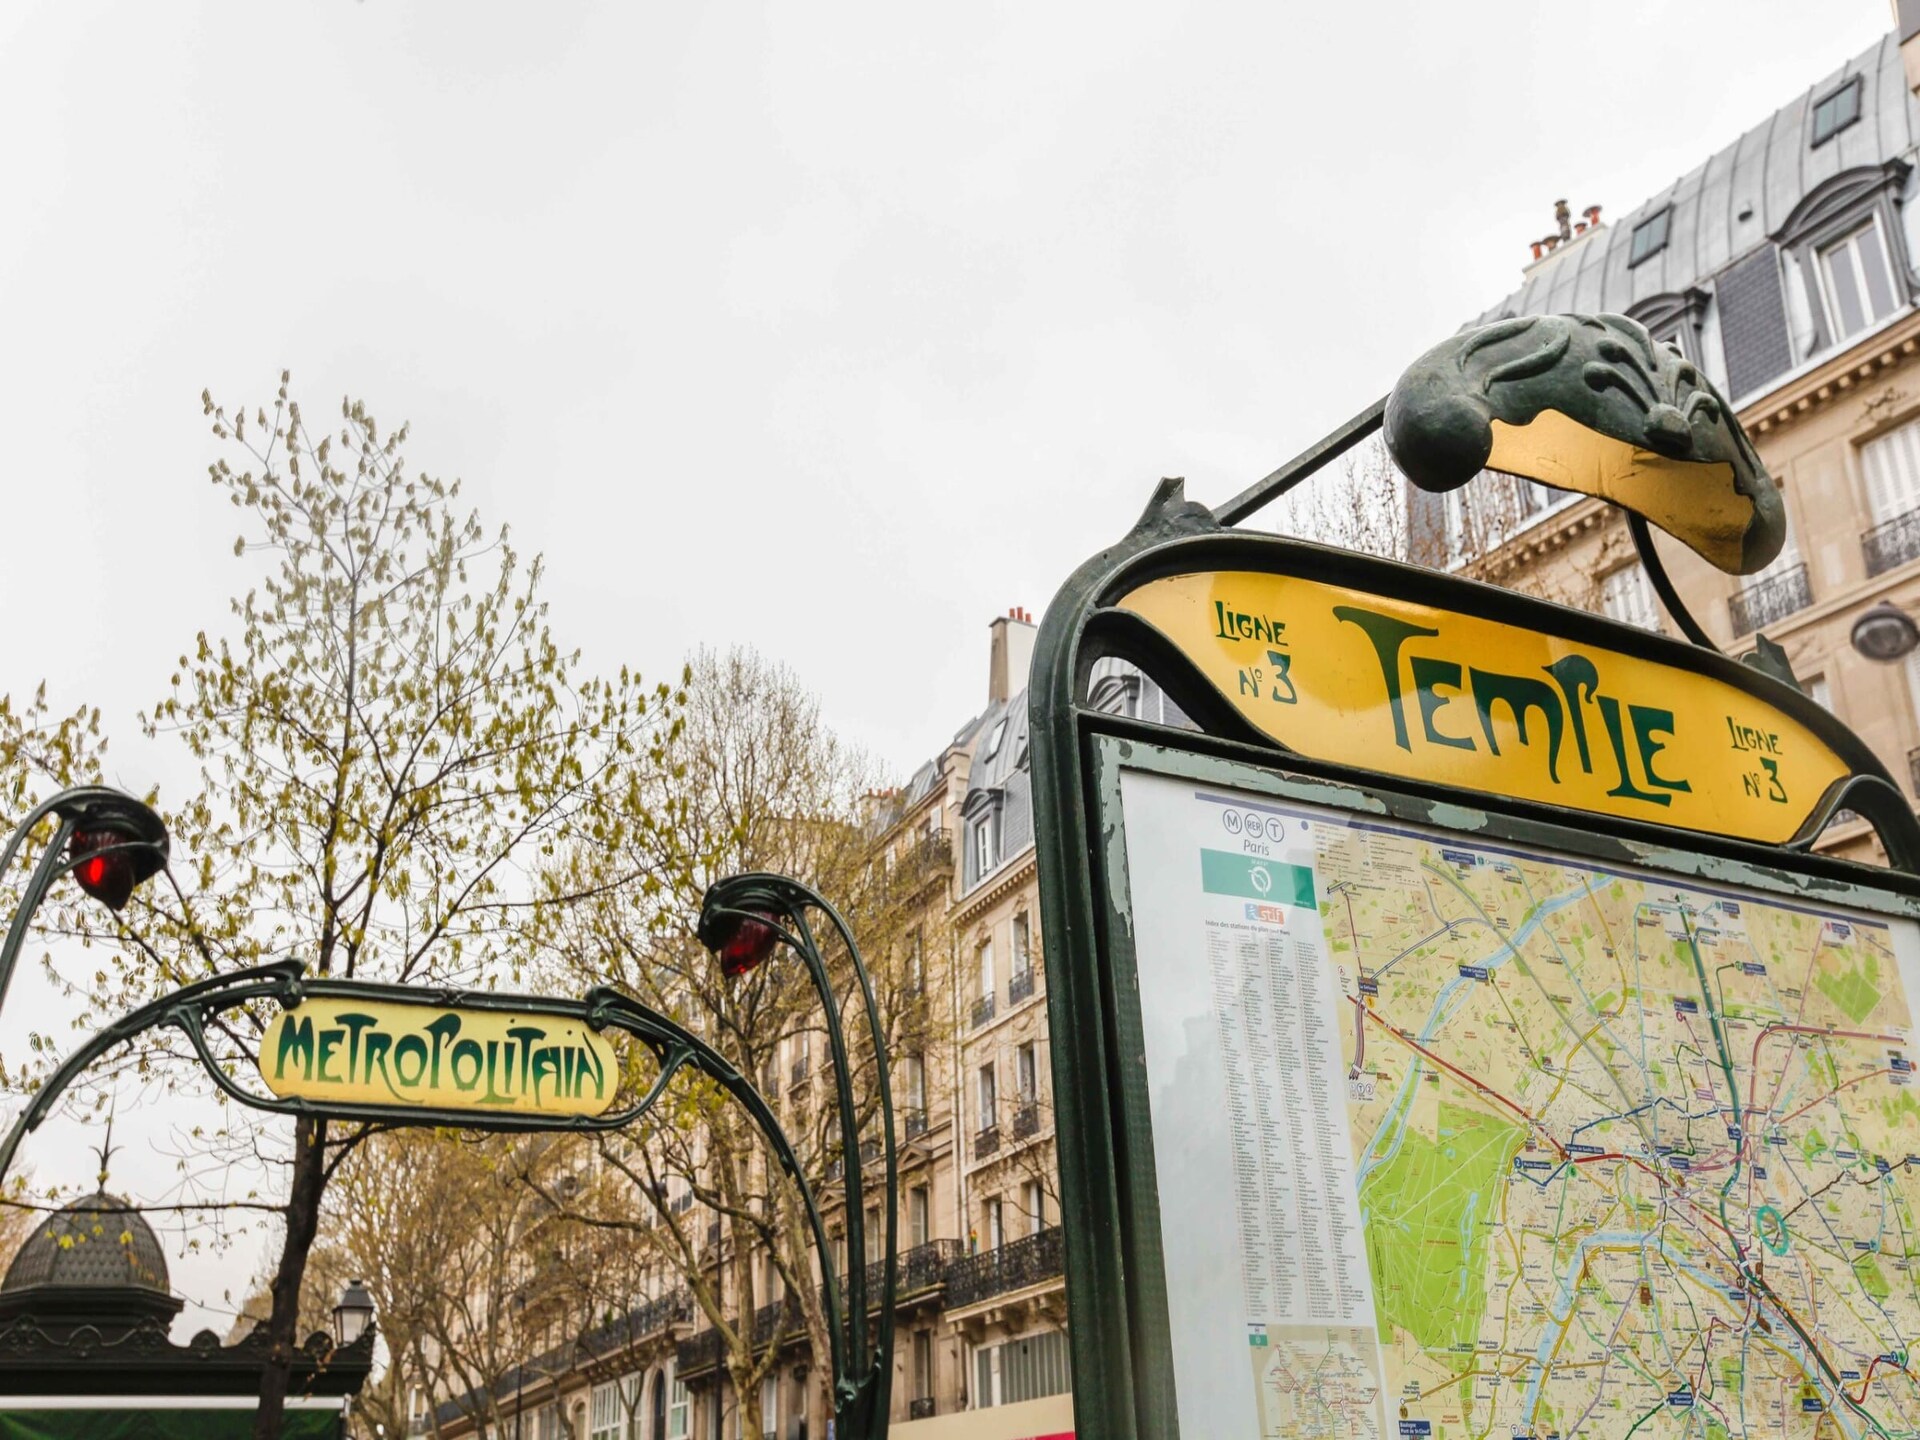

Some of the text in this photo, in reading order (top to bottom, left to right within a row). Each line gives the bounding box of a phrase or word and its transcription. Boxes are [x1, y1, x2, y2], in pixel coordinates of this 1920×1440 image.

[1267, 650, 1298, 704] 3
[1332, 605, 1692, 807] TEMPLE
[1760, 756, 1788, 804] 3
[1243, 839, 1270, 856] Paris
[1247, 820, 1261, 831] RER
[274, 1012, 604, 1107] METROPOLITAIN
